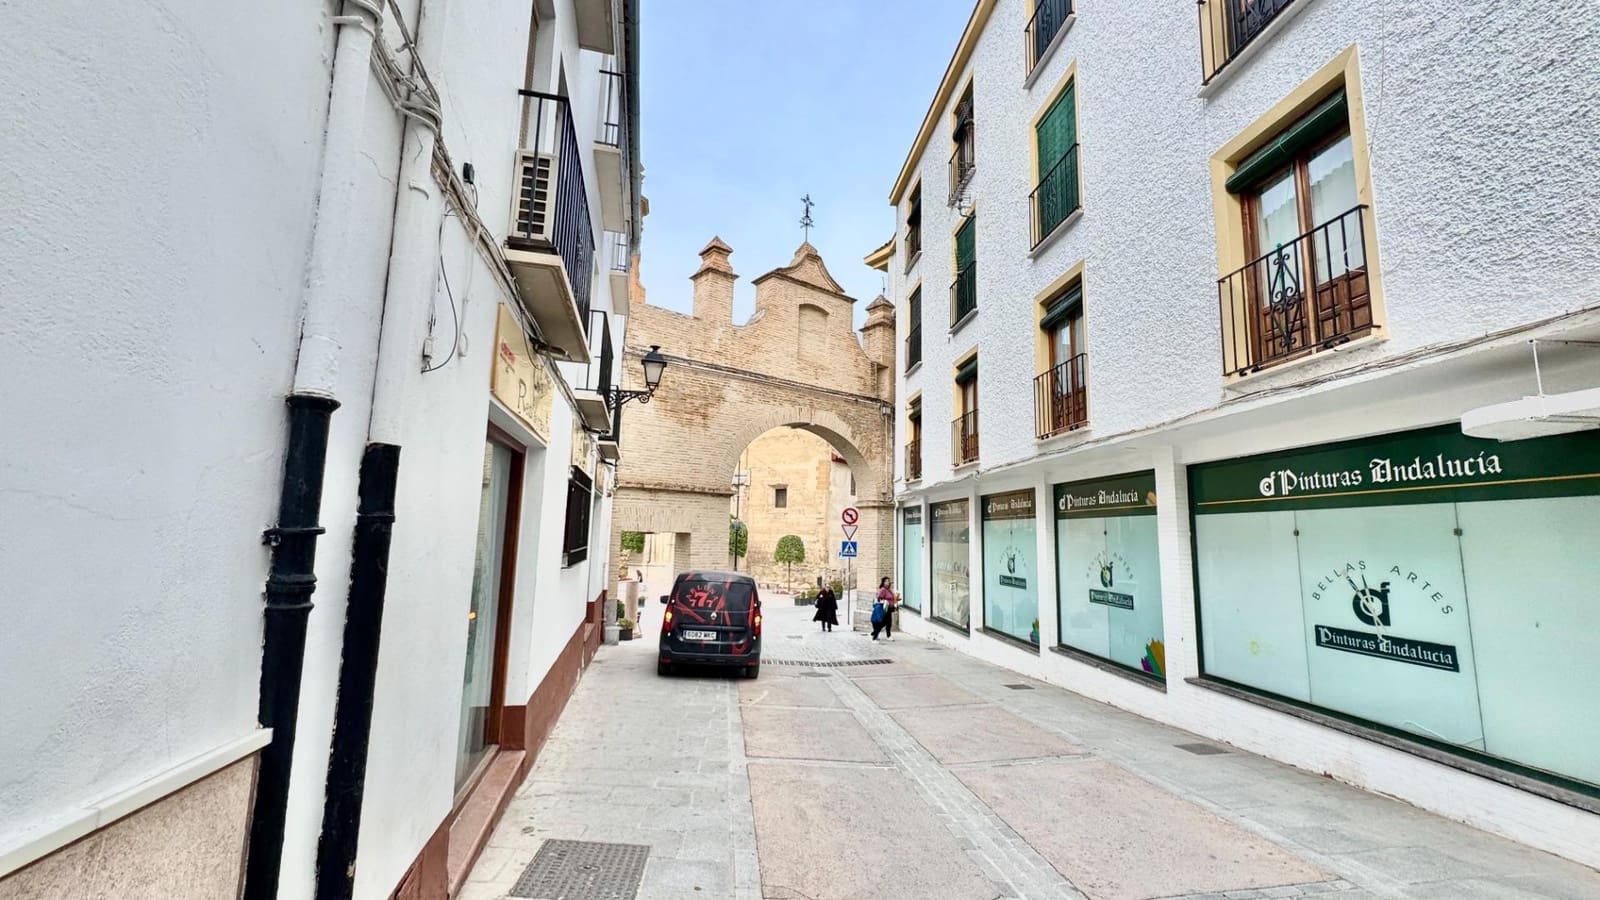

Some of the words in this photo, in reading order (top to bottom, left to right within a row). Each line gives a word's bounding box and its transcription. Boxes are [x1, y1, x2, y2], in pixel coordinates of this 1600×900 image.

[1278, 469, 1362, 495] Pinturas
[1369, 451, 1502, 483] Andalucía
[1312, 560, 1366, 600] BELLAS
[1390, 565, 1453, 614] ARTES
[1318, 627, 1375, 650] Pinturas
